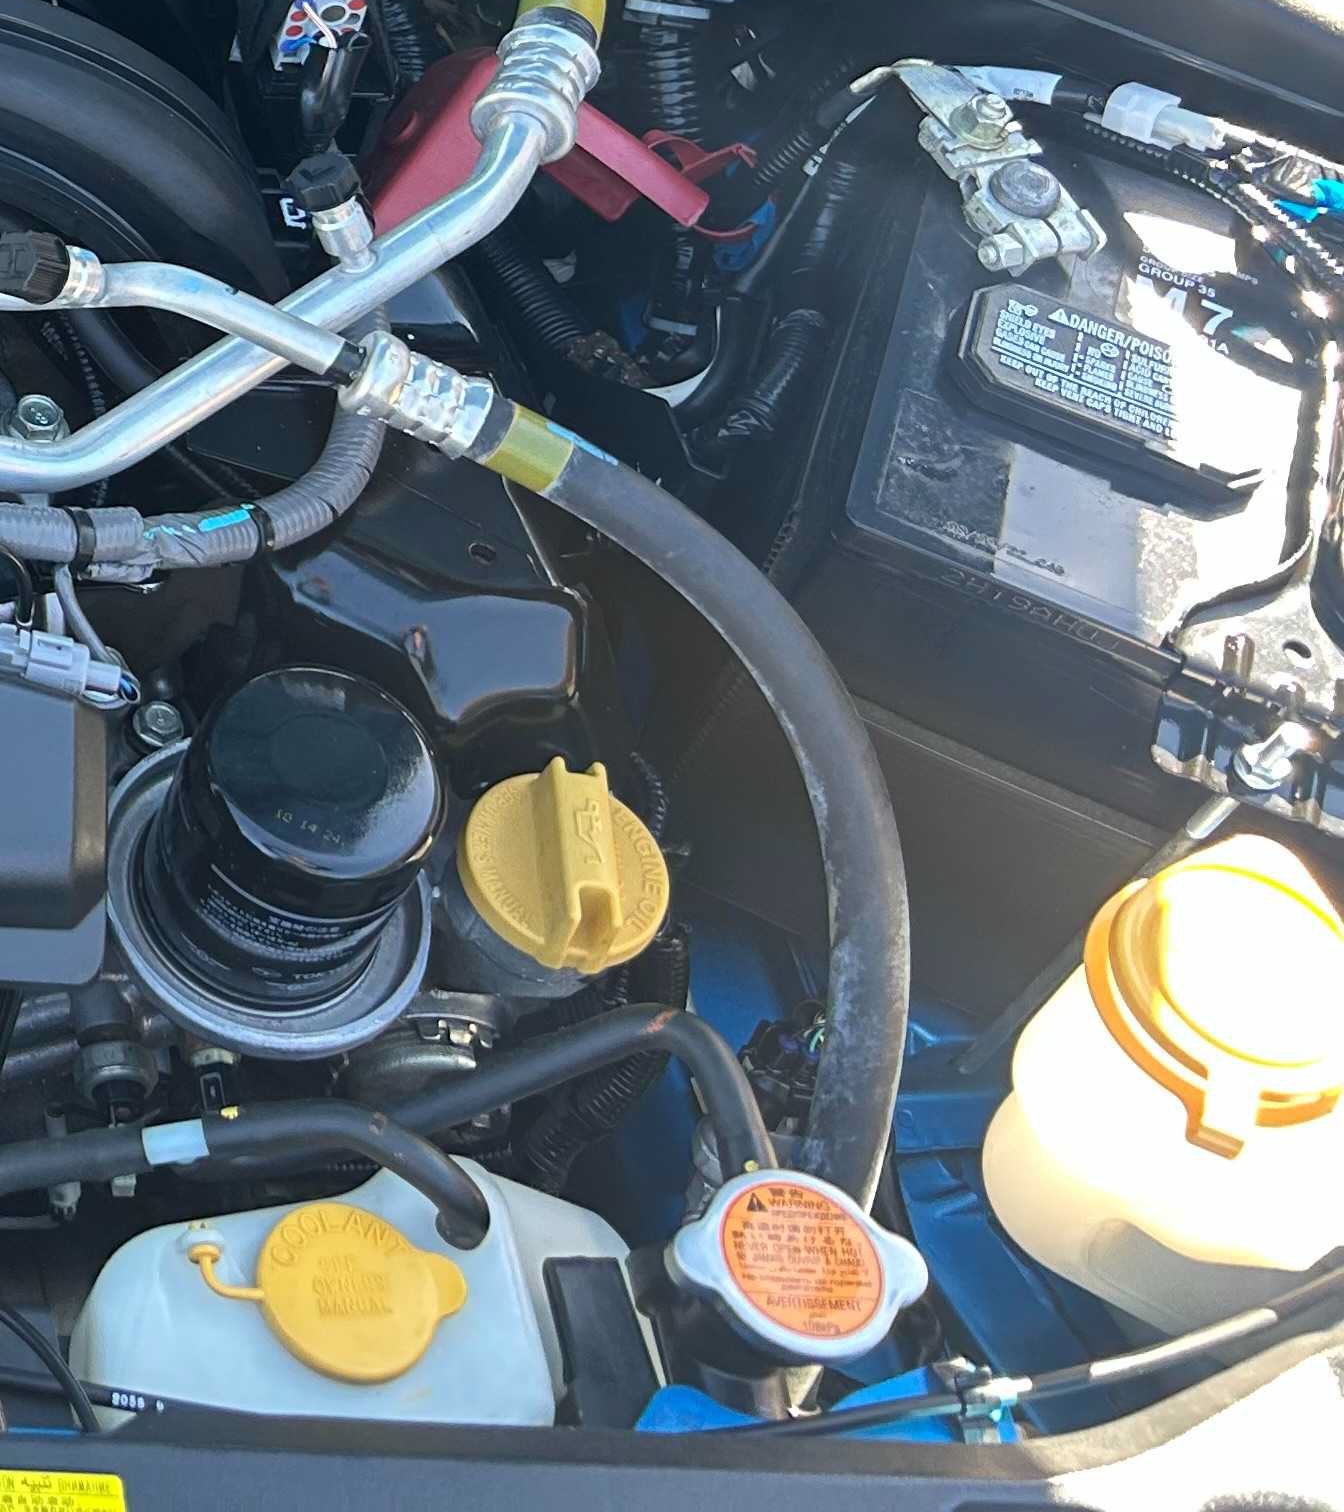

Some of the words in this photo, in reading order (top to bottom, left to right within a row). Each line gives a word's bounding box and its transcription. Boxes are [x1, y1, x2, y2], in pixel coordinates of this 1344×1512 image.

[1138, 263, 1196, 288] GROUP
[1069, 313, 1173, 365] DANGER/POISO
[999, 354, 1024, 371] KEEP
[1025, 364, 1045, 381] OUT
[1034, 376, 1059, 394] KEEP
[611, 806, 662, 896] ENGINE
[625, 899, 659, 935] OIL
[270, 1209, 413, 1268] COOLANT
[766, 1295, 862, 1312] AVERTISSEMENT
